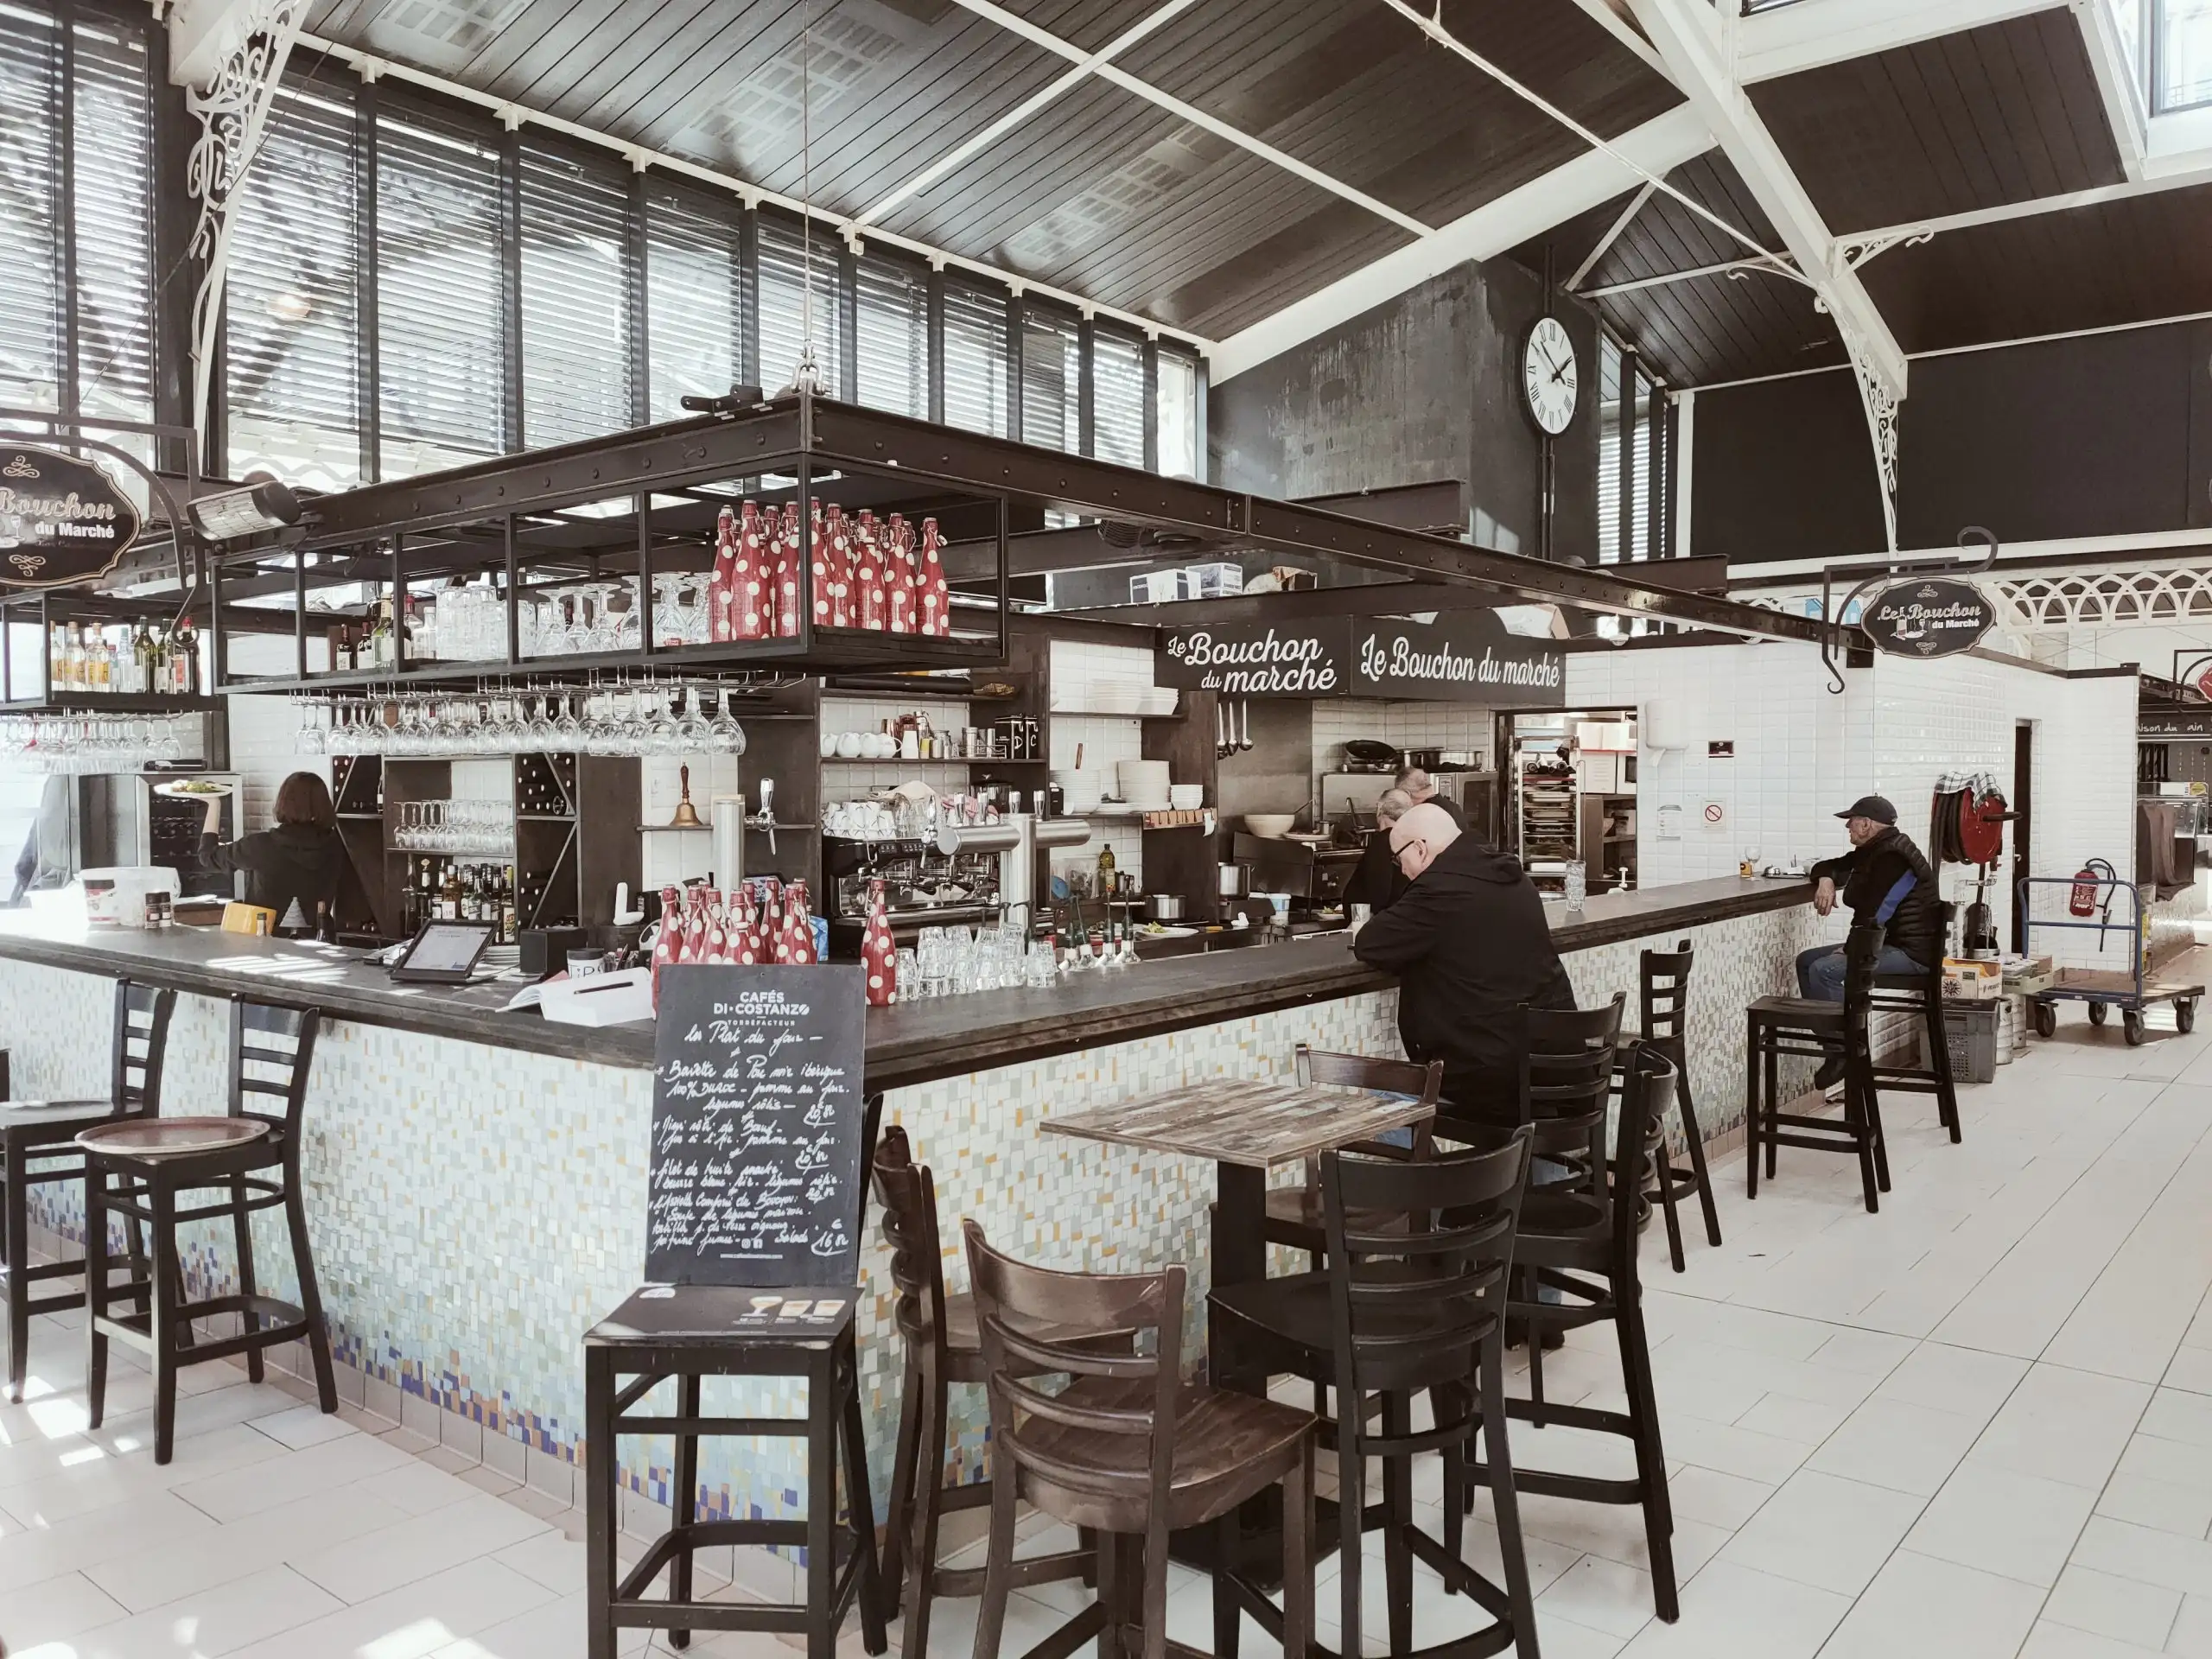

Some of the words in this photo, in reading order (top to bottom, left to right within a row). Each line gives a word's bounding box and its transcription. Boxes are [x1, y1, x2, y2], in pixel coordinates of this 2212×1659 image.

[0, 486, 117, 520] Bouchon
[35, 522, 54, 536] du
[59, 522, 115, 539] Marché
[1877, 604, 1898, 621] Le
[1904, 601, 1982, 620] Bouchon
[1931, 620, 1944, 630] du
[1945, 618, 1980, 629] Marché
[1167, 635, 1186, 658] Le
[1185, 624, 1324, 666] Bouchon
[1360, 632, 1387, 683] Le
[1389, 636, 1477, 683] Bouchon
[1478, 646, 1501, 683] du
[1502, 652, 1560, 688] marché
[1201, 669, 1222, 690] du
[1223, 657, 1338, 693] marché
[2138, 722, 2160, 733] ison
[2164, 722, 2177, 733] du
[740, 989, 785, 1003] CAFÉS
[743, 1027, 766, 1044] du
[722, 1061, 740, 1078] de
